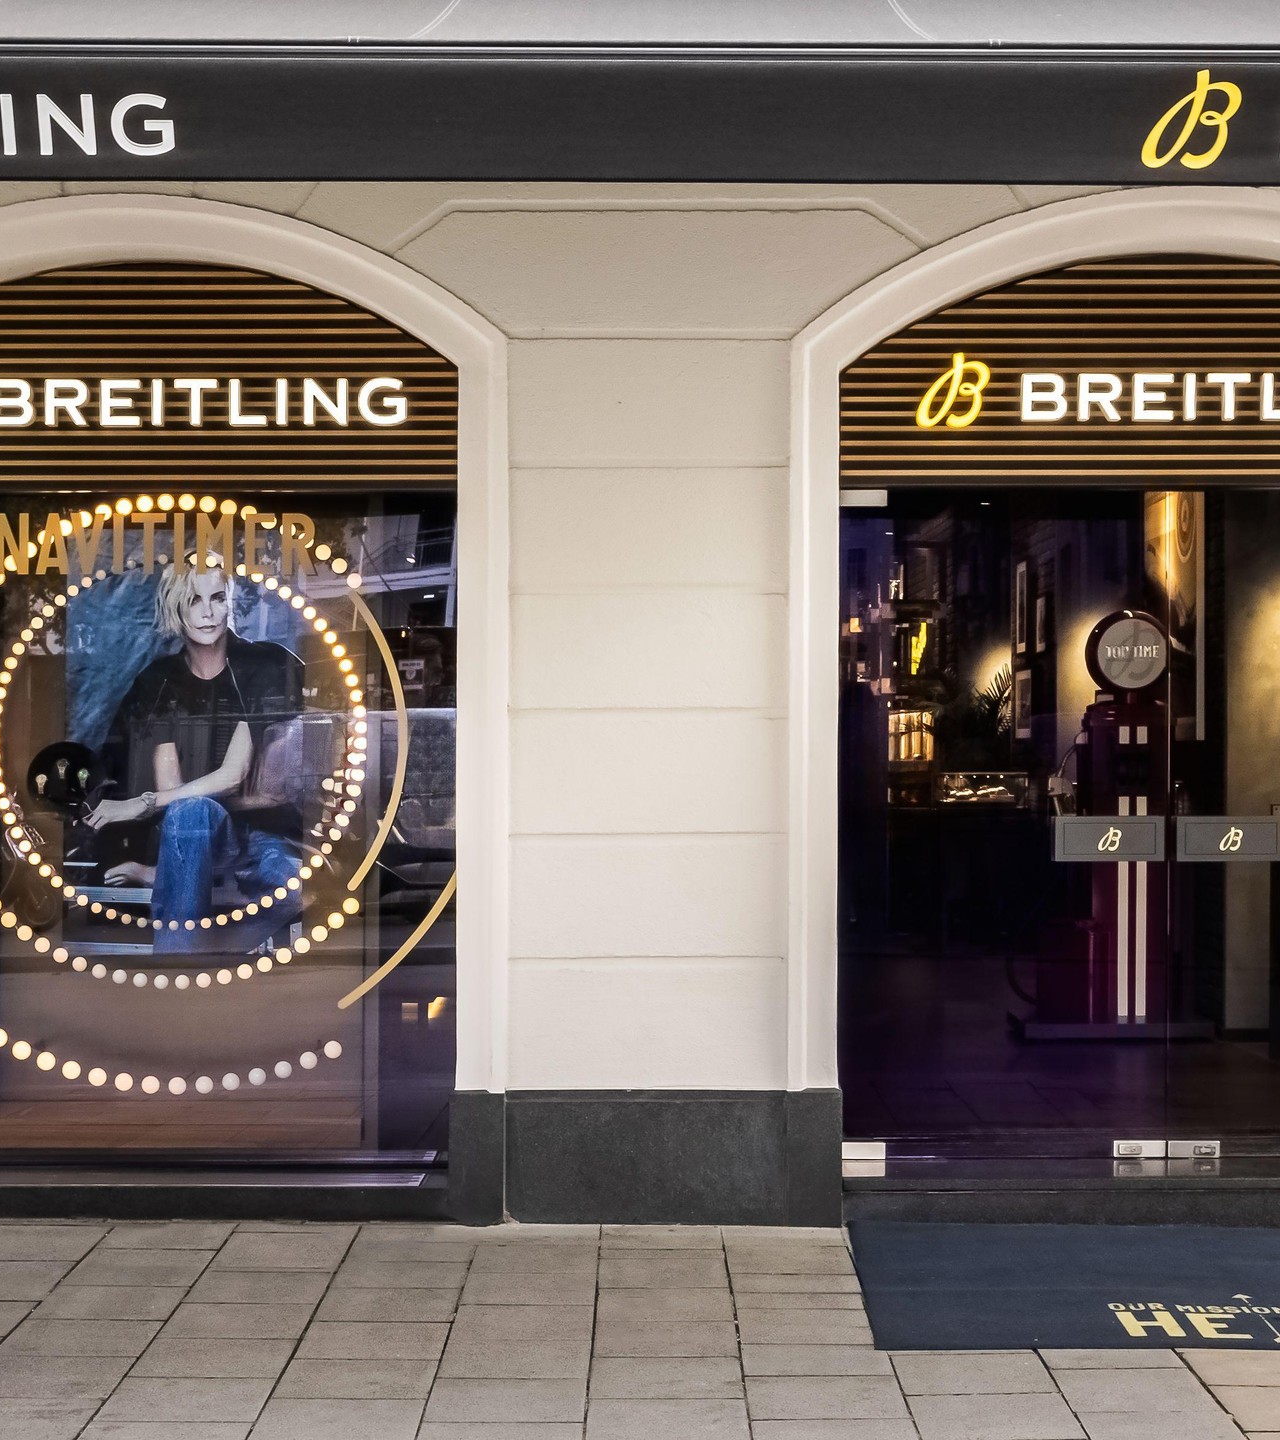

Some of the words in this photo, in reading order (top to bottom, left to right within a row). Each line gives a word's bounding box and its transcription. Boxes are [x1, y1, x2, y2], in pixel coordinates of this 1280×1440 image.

[1105, 645, 1130, 659] TOP
[1133, 645, 1160, 658] TIME
[1107, 1302, 1167, 1312] OUR
